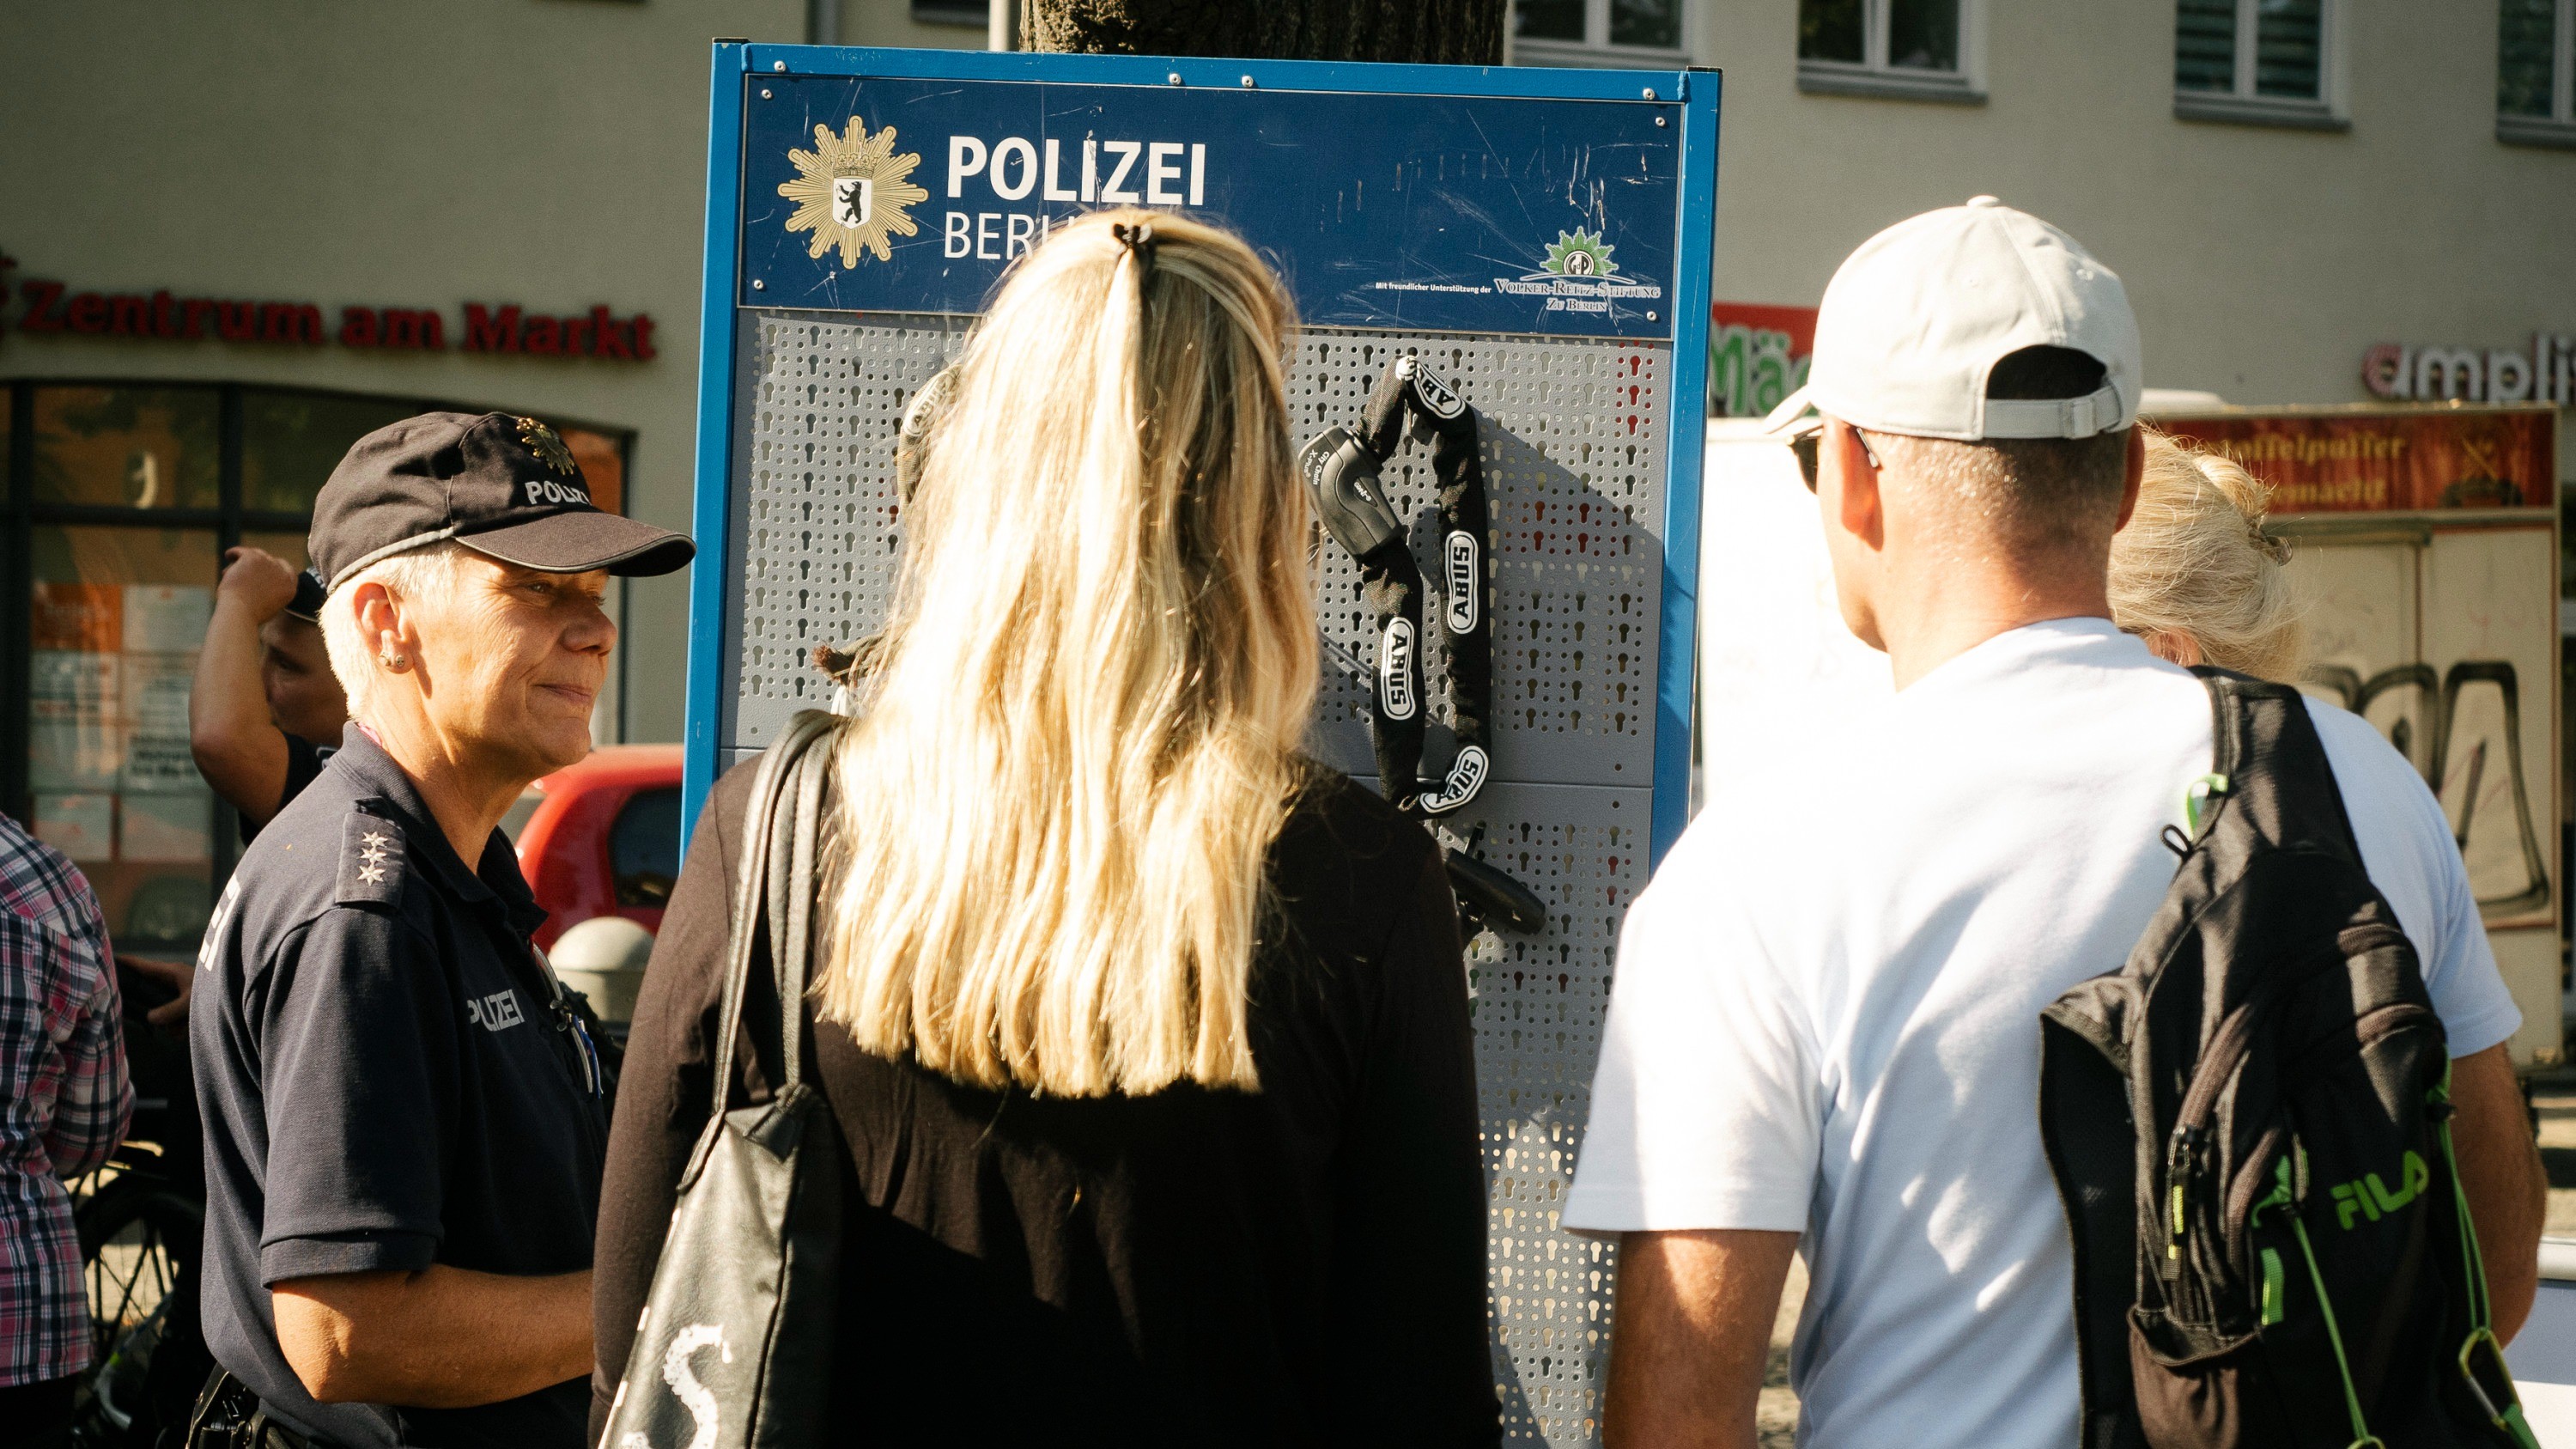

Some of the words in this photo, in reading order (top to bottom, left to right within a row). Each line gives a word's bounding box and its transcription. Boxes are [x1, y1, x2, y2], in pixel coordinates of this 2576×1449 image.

[947, 135, 1206, 206] POLIZEI
[21, 279, 323, 344] Zentrum
[340, 305, 445, 349] am
[463, 301, 657, 362] Markt
[1375, 282, 1388, 290] Mit
[1388, 282, 1430, 292] freundlicher
[1430, 283, 1479, 295] Unterstützung
[1479, 285, 1492, 294] der
[2360, 332, 2576, 408] ampli
[524, 480, 592, 506] POLIZ
[1312, 465, 1322, 485] Chain
[1318, 451, 1330, 465] City
[1452, 546, 1470, 620] ABUS
[1389, 632, 1408, 705] ABUS
[2330, 1149, 2430, 1230] FILA
